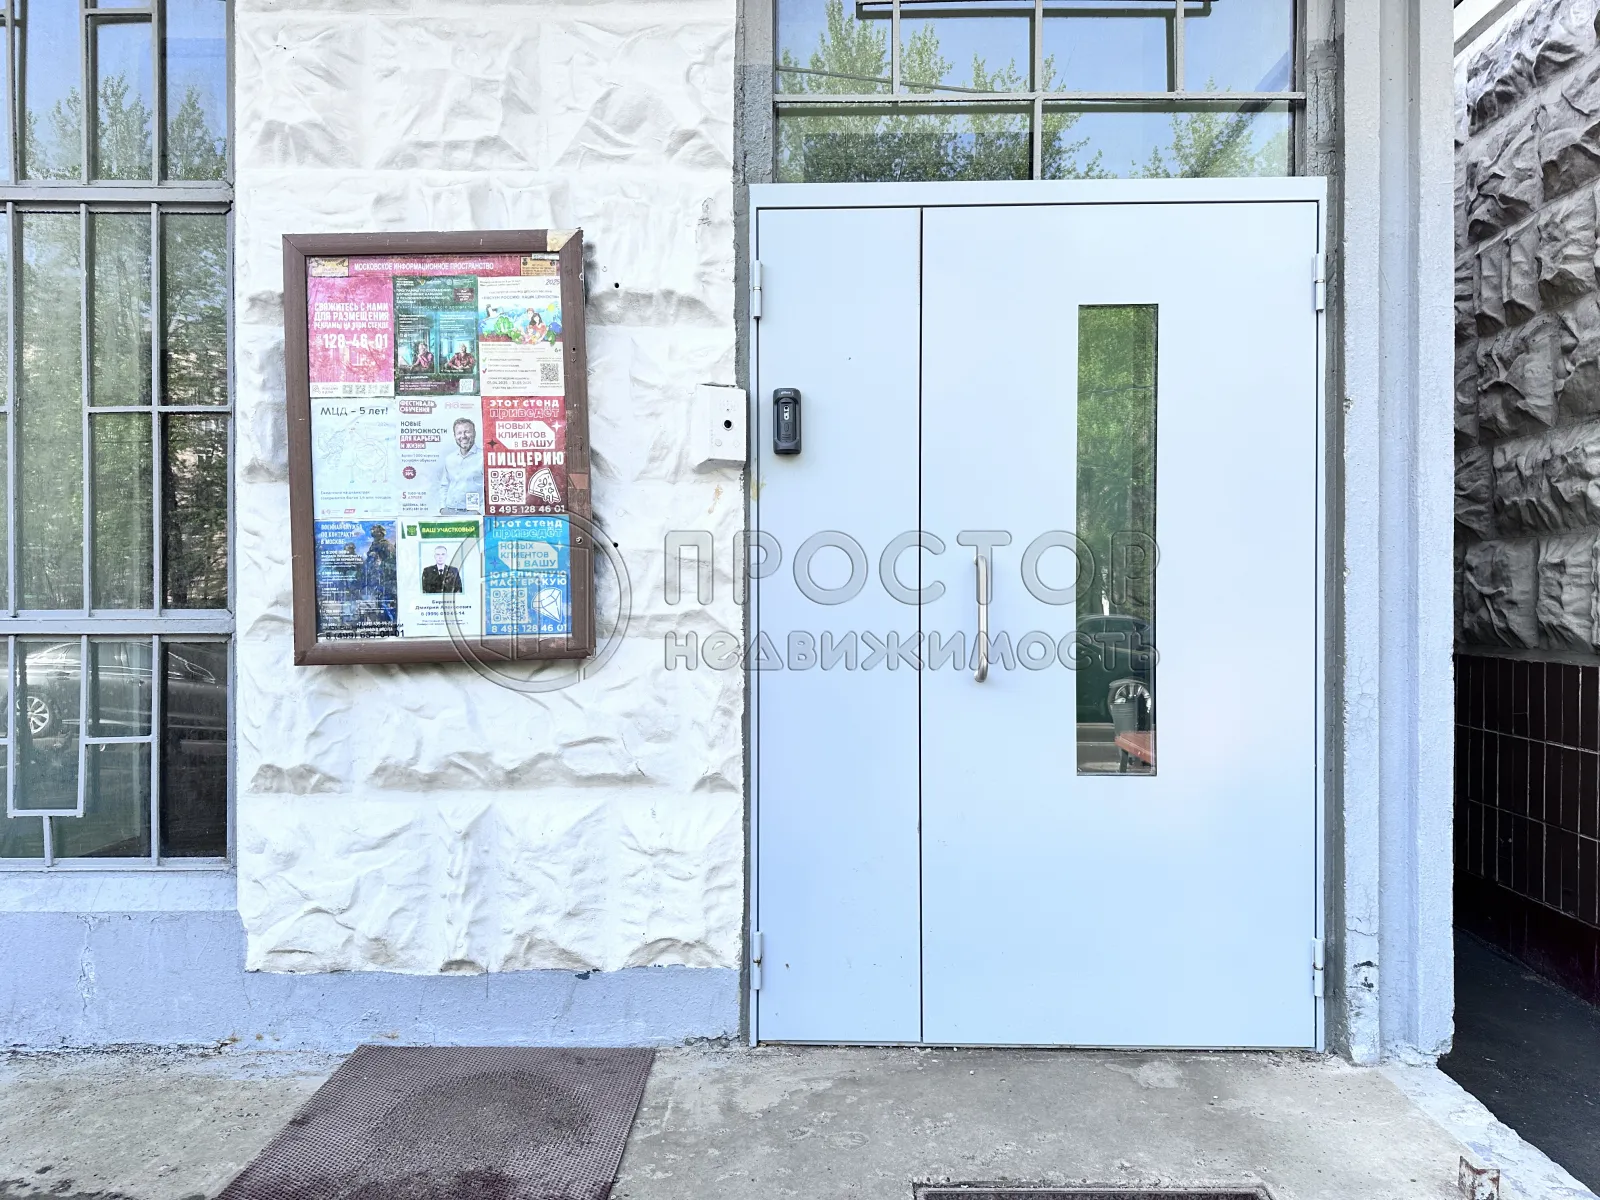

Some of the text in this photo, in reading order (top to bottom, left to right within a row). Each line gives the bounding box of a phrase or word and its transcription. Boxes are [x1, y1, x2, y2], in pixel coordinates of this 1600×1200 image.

[314, 302, 358, 311] СВЯЖИТЕСЬ
[361, 302, 365, 311] С
[367, 302, 388, 311] НАМИ
[314, 311, 389, 321] ДЛЯ РАЗМЕЩЕНИЯ
[323, 333, 388, 348] 128-46-01
[320, 407, 348, 416] МЦД
[360, 407, 365, 415] 5
[490, 407, 560, 419] приведёт
[488, 452, 564, 467] ПИЦЦЕРИЮ
